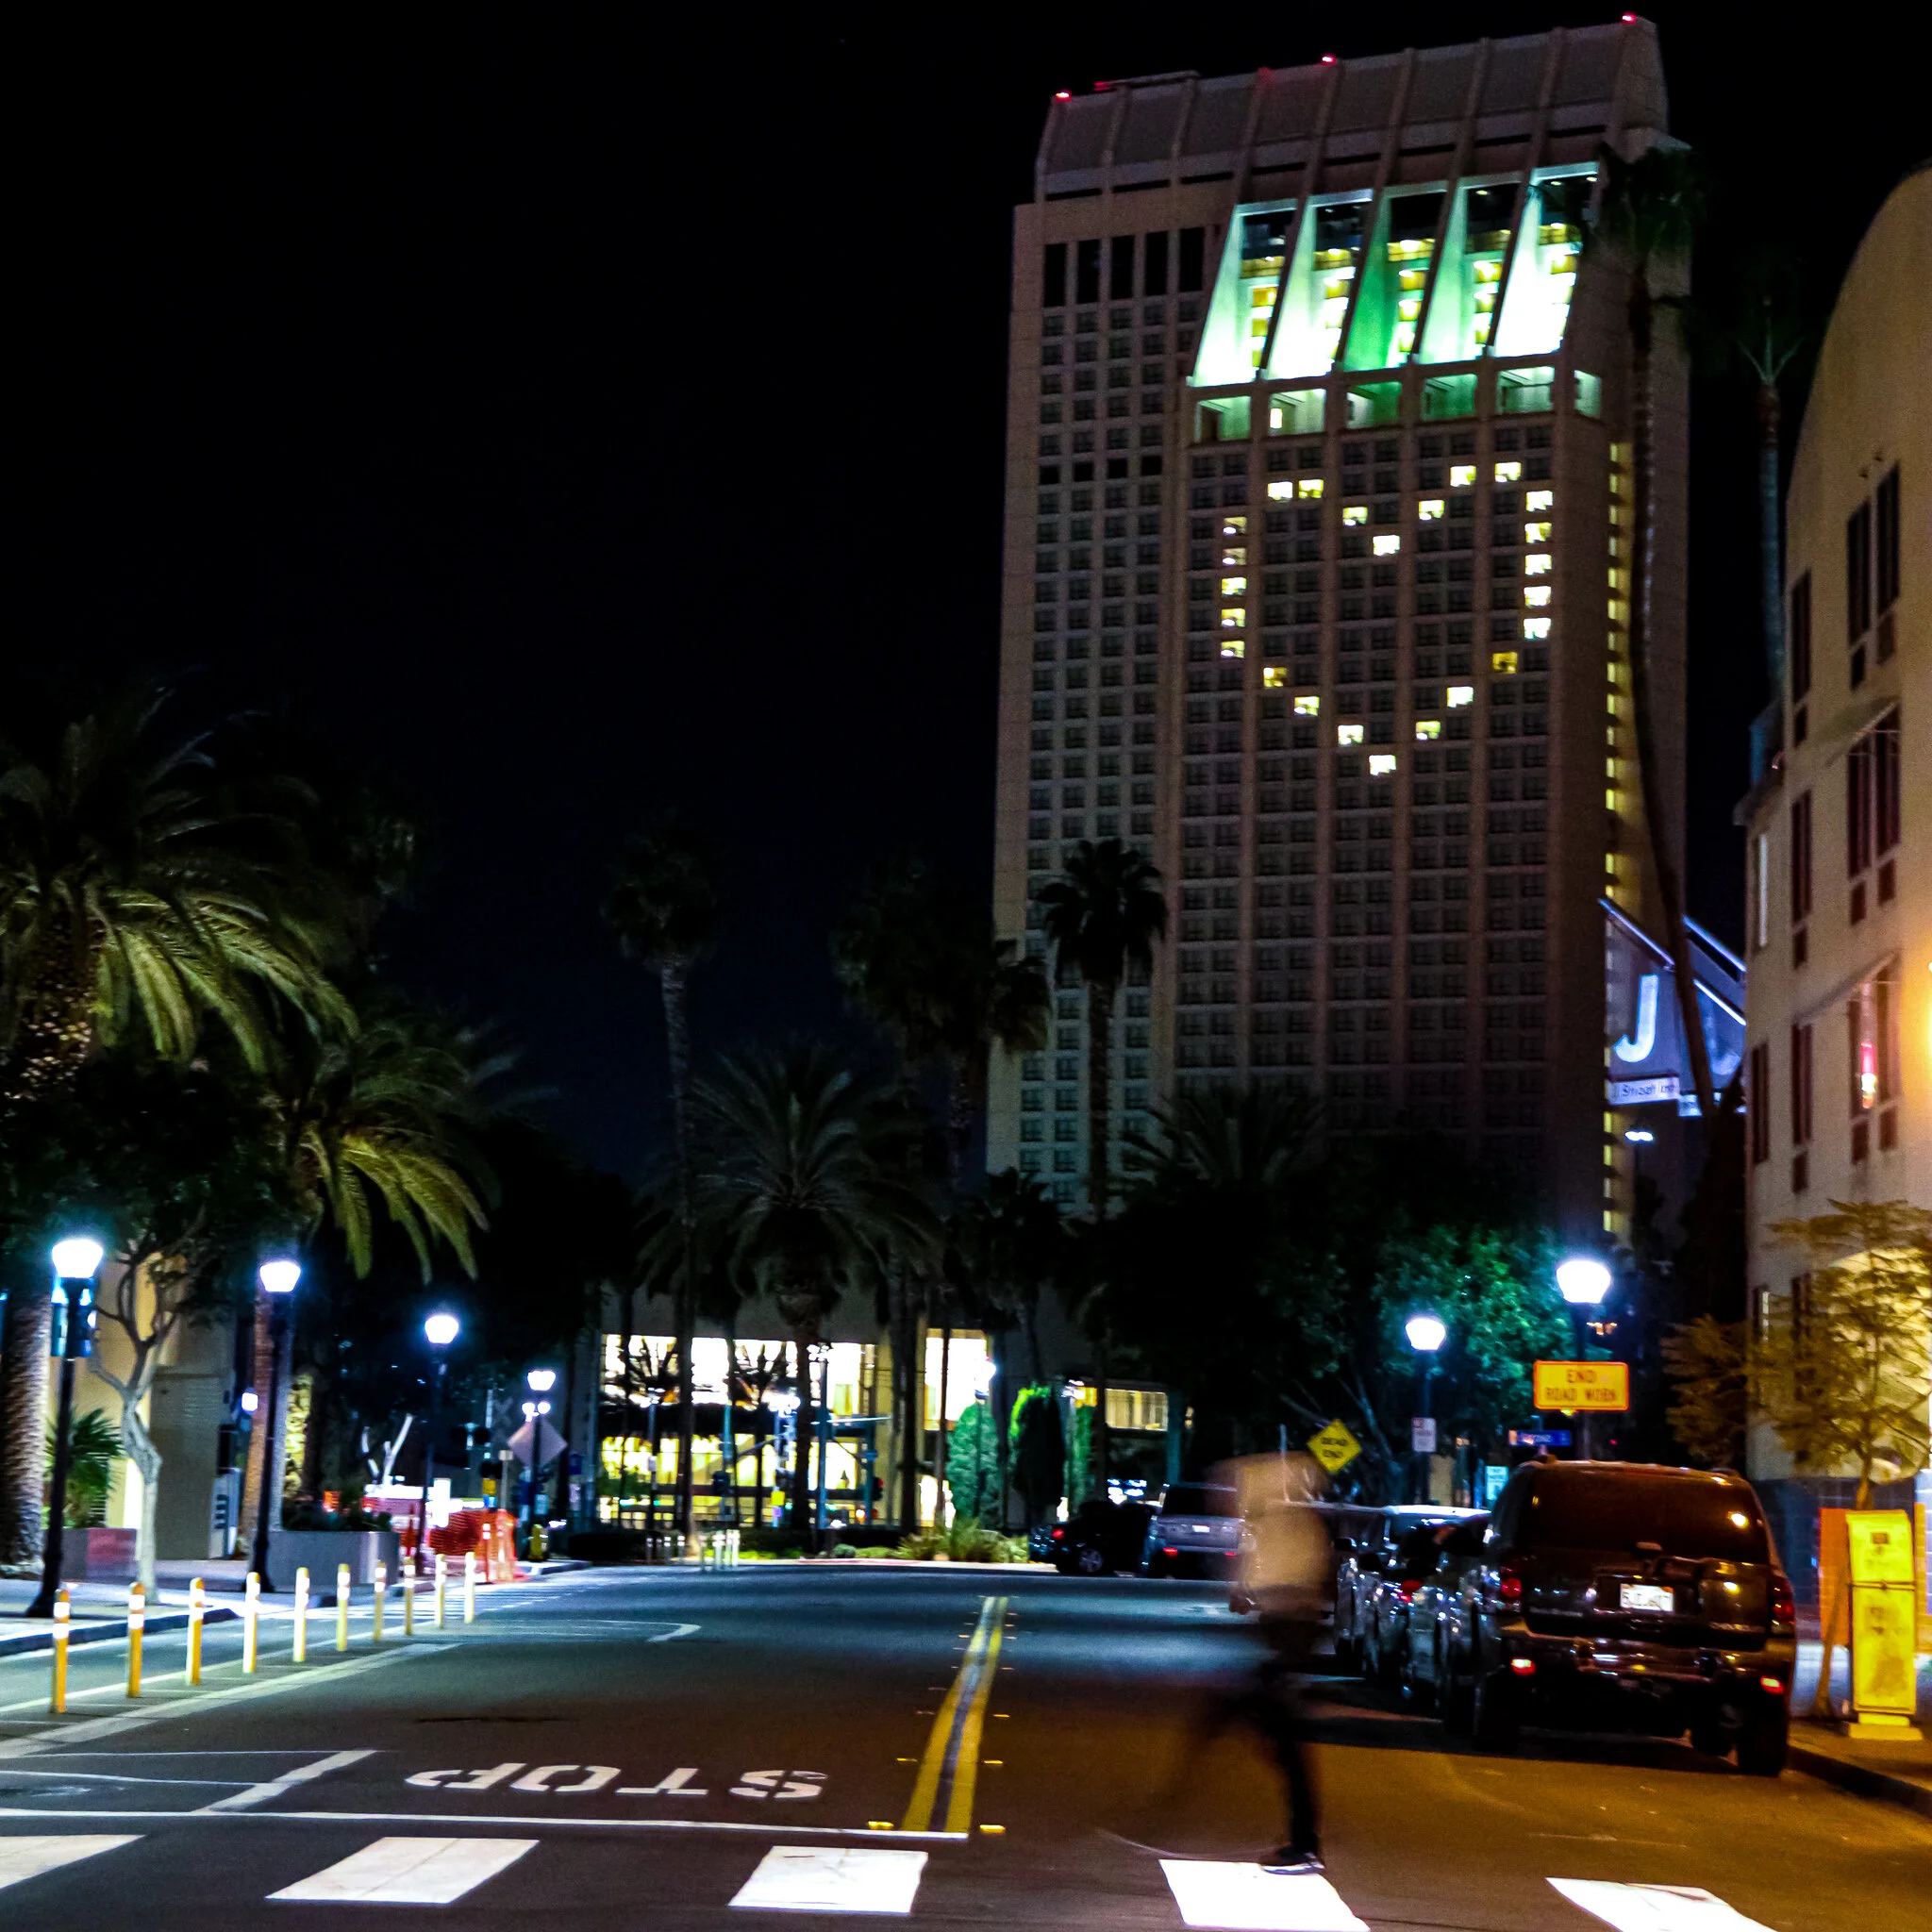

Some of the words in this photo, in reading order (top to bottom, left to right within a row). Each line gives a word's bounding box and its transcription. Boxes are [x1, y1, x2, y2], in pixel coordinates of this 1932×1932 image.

[1613, 974, 1659, 1062] J
[1566, 1369, 1597, 1384] END
[1544, 1387, 1578, 1402] ROAD
[1585, 1388, 1617, 1403] WORK
[1322, 1437, 1349, 1447] DEAD
[1323, 1448, 1344, 1459] END
[405, 1762, 828, 1799] STOP
